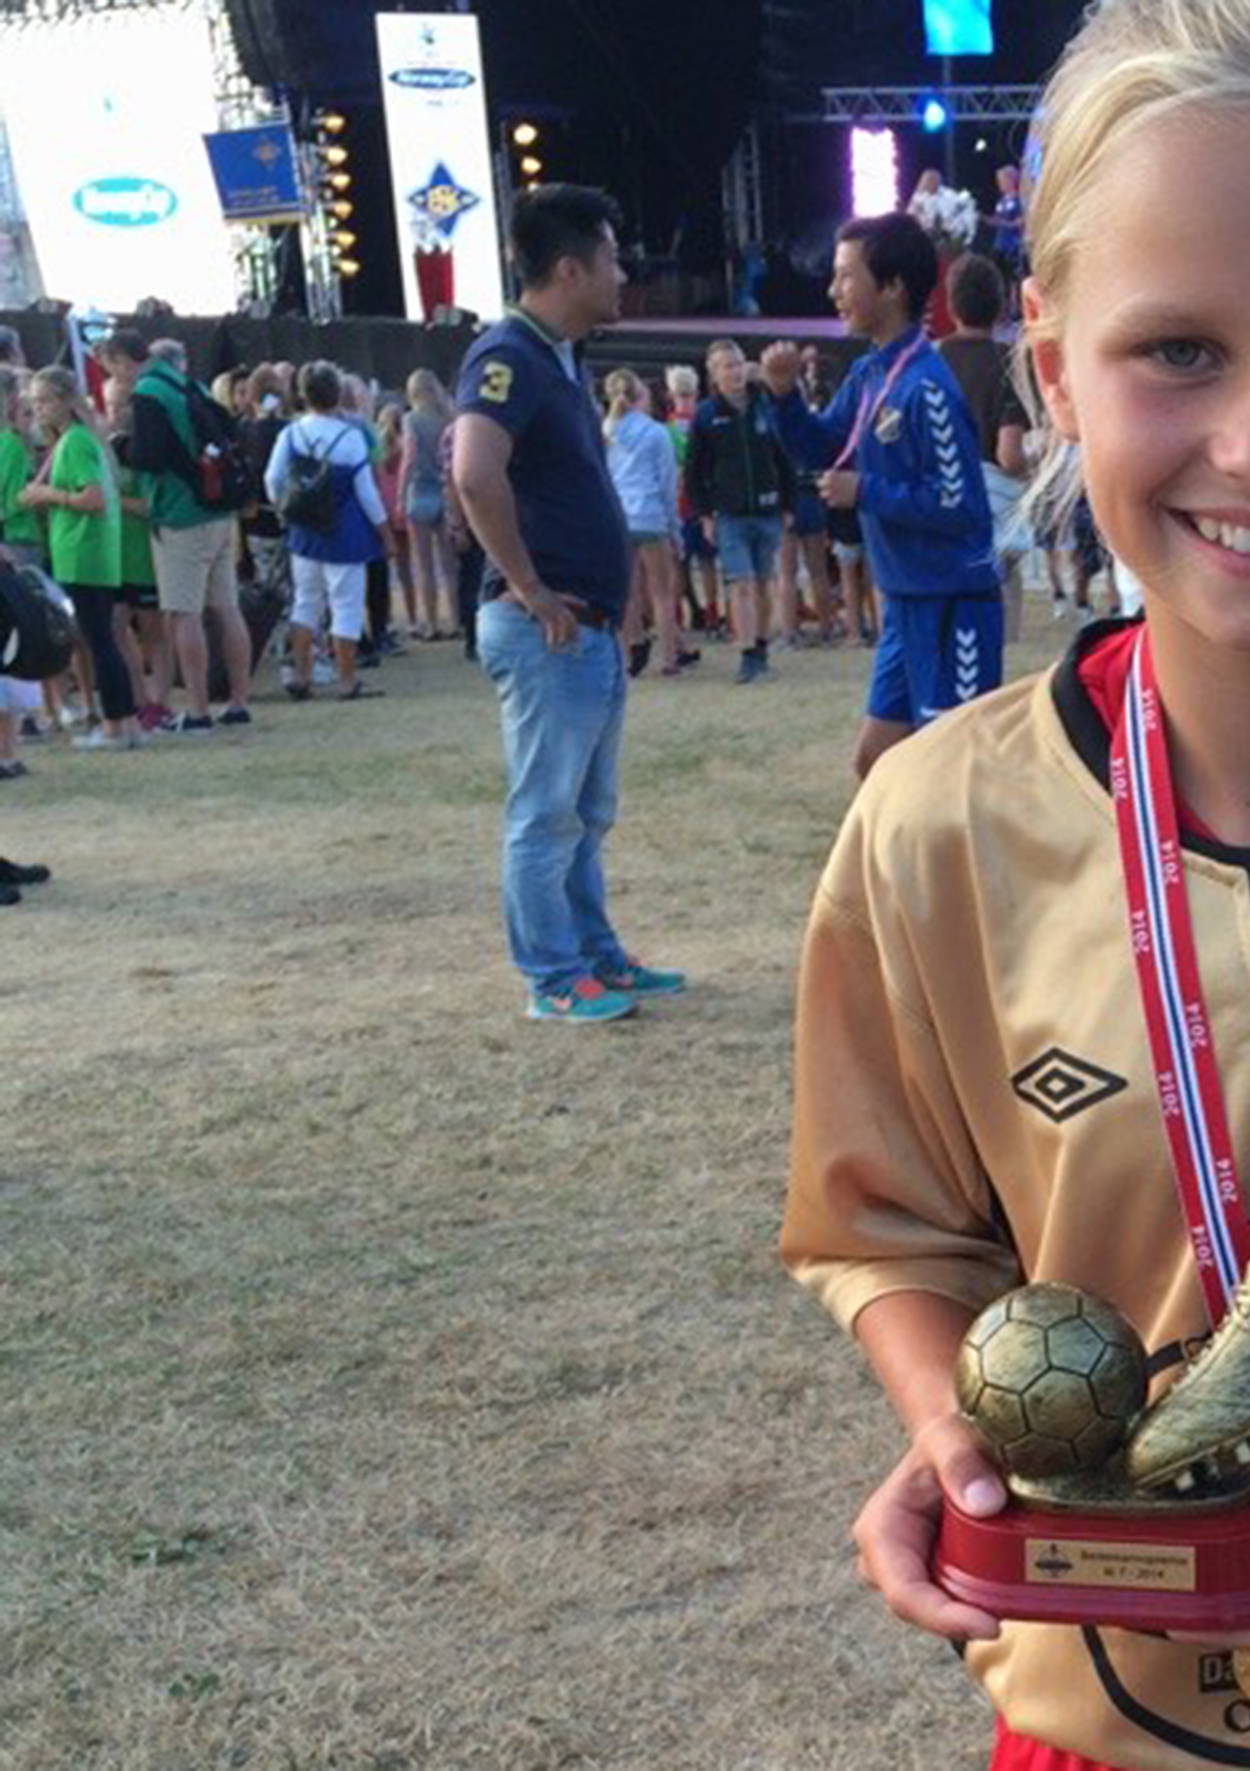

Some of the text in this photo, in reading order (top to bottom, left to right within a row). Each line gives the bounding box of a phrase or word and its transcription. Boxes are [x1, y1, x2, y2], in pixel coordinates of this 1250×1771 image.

[479, 360, 513, 403] 3
[1160, 840, 1180, 884] 2014
[1132, 909, 1150, 955] 2014
[1185, 1002, 1208, 1049] 2014
[1156, 1071, 1181, 1116] 2014
[1215, 1158, 1238, 1204] 2014
[1191, 1224, 1214, 1267] 2014
